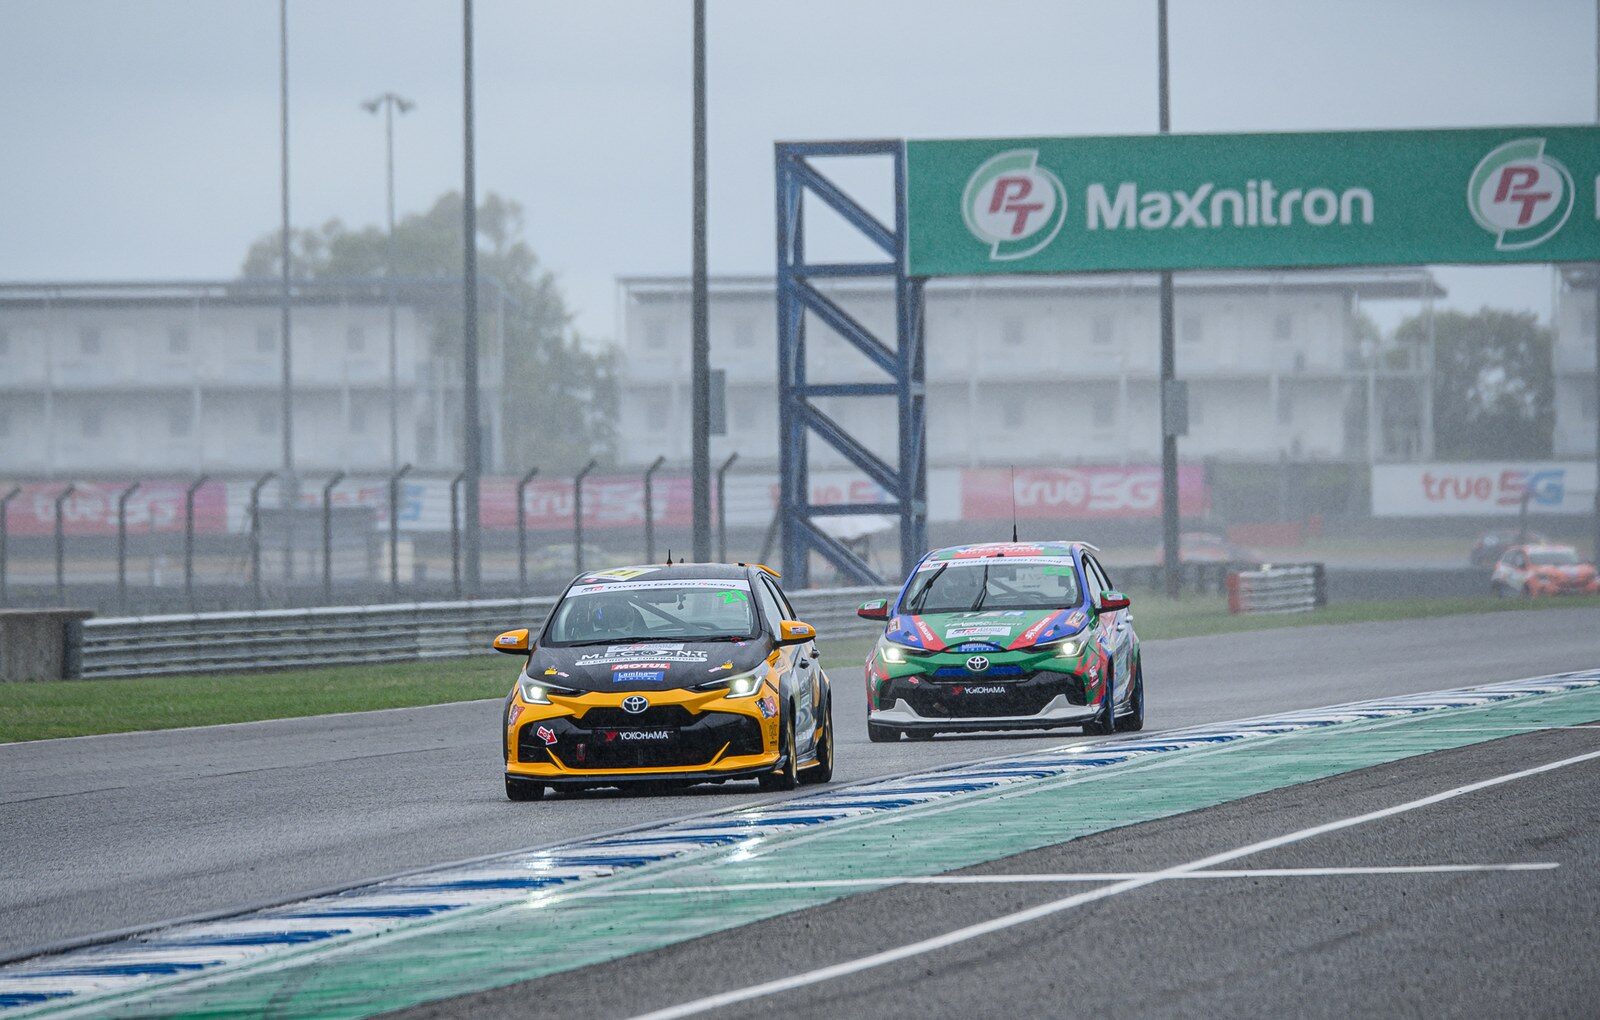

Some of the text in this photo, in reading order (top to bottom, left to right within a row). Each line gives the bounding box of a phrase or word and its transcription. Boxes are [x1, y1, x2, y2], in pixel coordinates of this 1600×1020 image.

[989, 176, 1374, 236] PT Maxnitron
[1493, 165, 1553, 225] PT
[964, 686, 1006, 694] YOKOHAMA
[619, 731, 669, 741] YOKOHAMA
